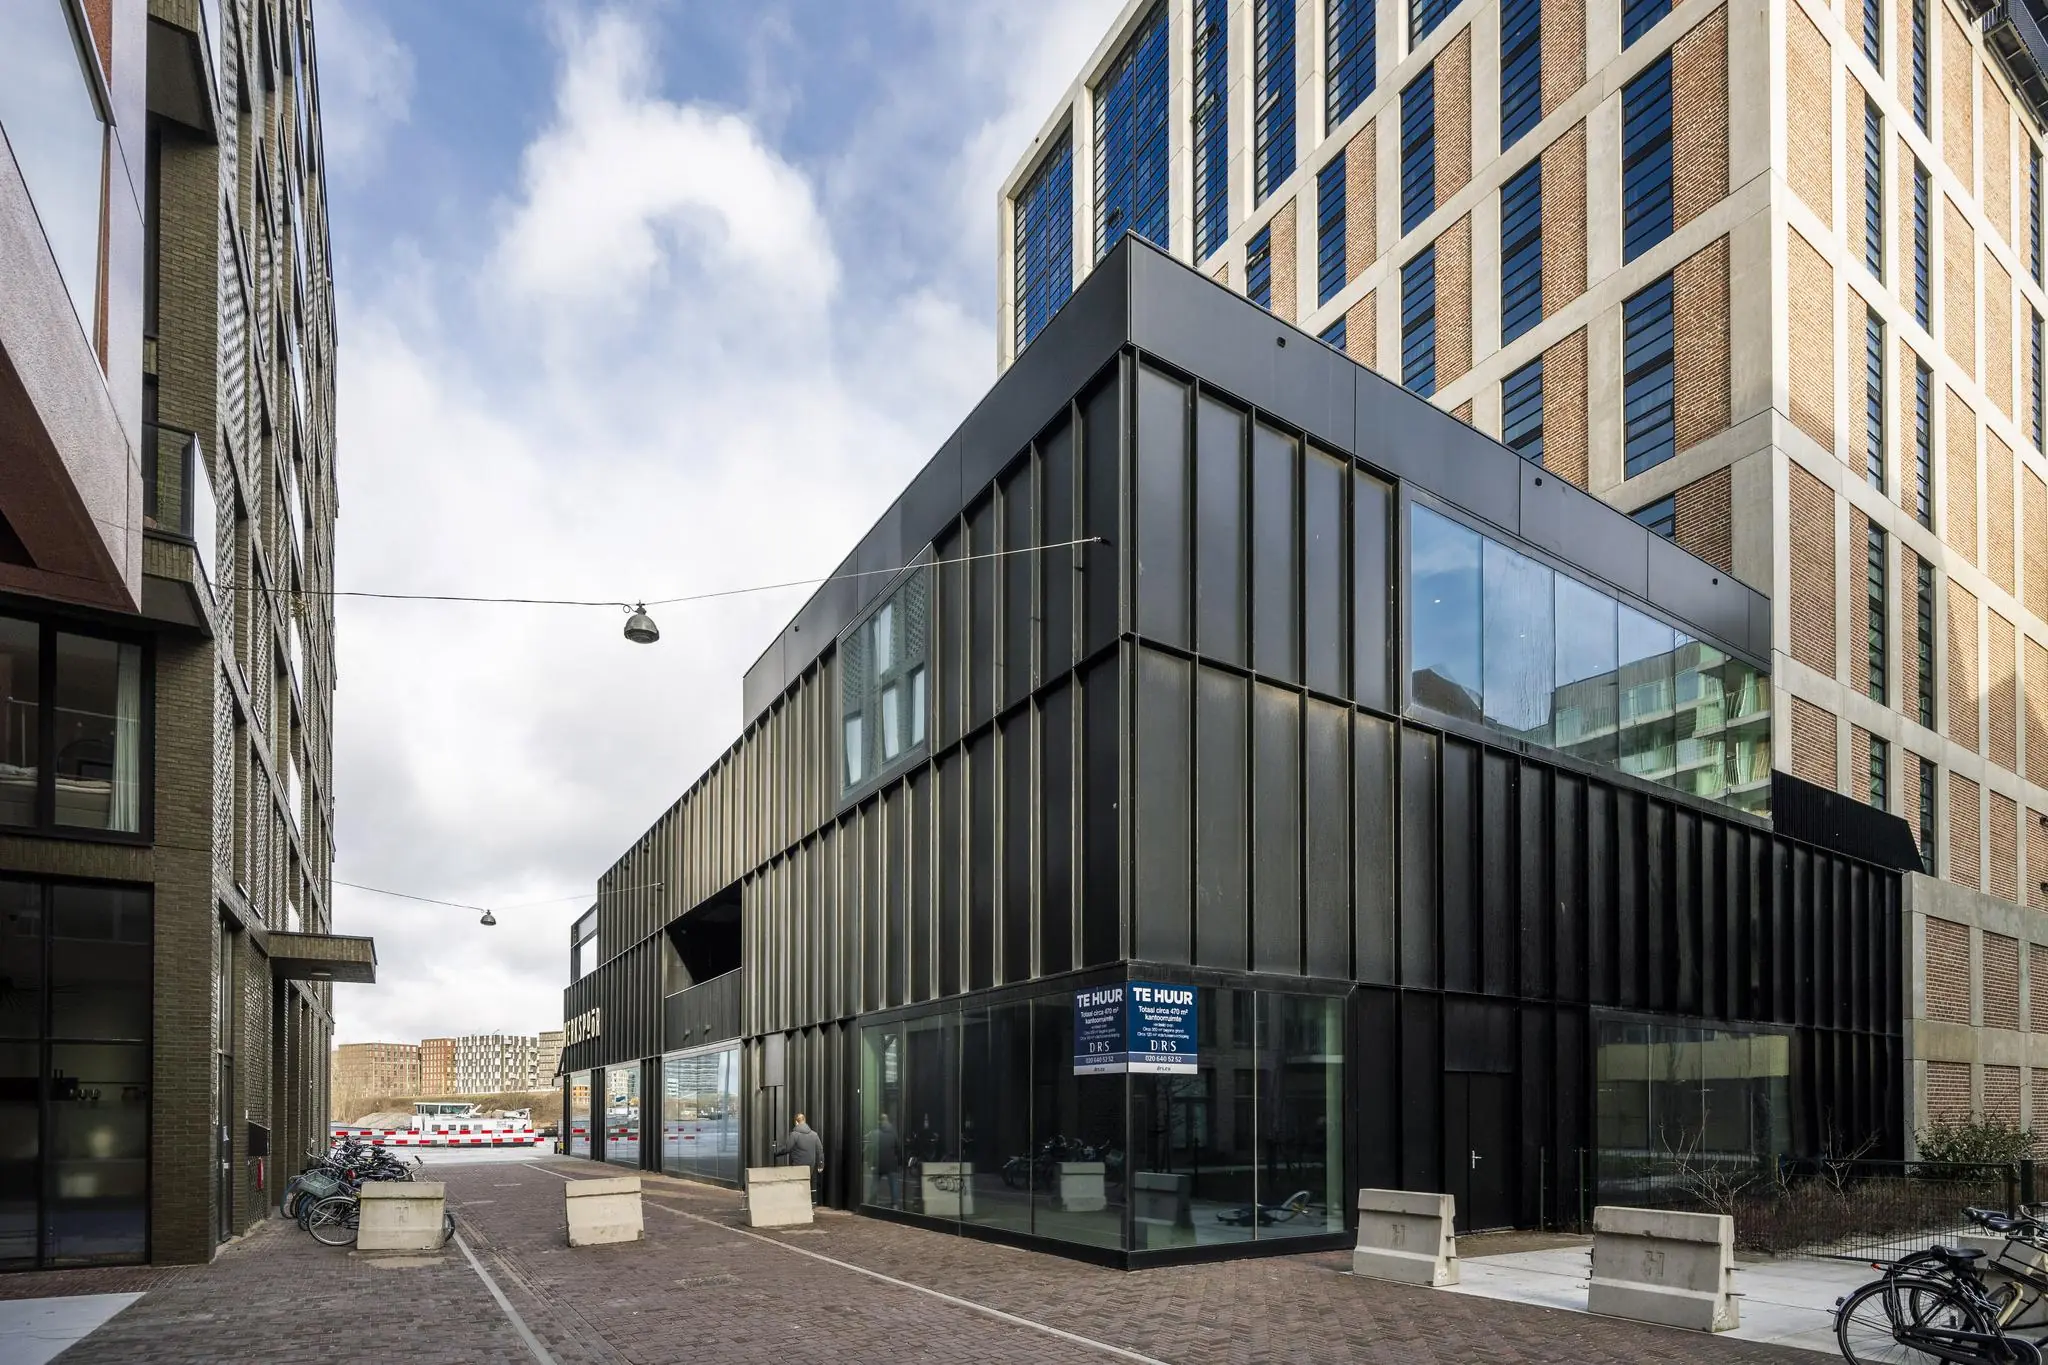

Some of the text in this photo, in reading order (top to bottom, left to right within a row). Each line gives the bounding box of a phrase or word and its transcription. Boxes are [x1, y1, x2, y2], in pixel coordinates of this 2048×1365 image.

[1077, 988, 1123, 1008] TE HUUR
[1132, 987, 1193, 1006] TE HUUR
[1138, 1005, 1155, 1014] Totaal
[1155, 1006, 1170, 1015] circa
